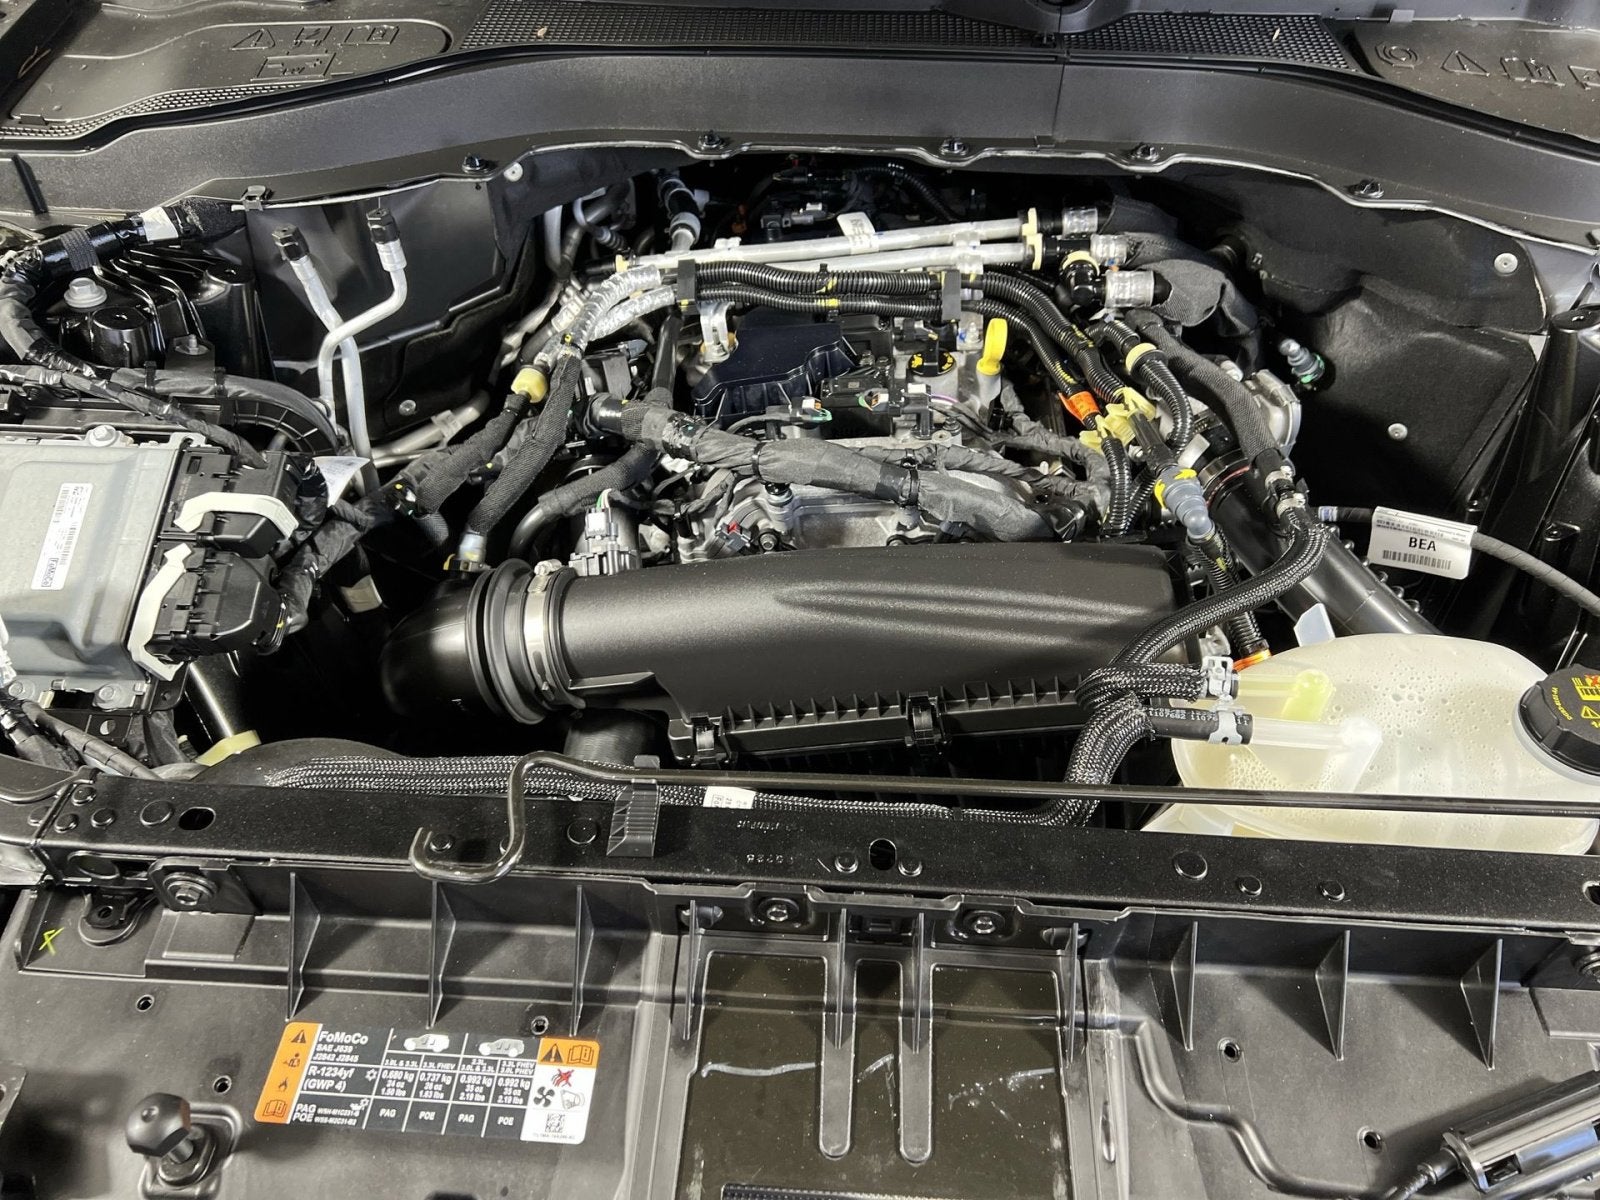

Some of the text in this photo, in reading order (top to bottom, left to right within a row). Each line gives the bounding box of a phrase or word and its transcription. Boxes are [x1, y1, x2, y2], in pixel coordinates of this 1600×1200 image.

[1408, 536, 1436, 552] BEA
[318, 1030, 369, 1045] FoMoCo
[315, 1043, 354, 1053] SAE J639
[436, 1062, 456, 1070] FHEV
[307, 1065, 355, 1080] R-1234yf
[403, 1071, 415, 1083] kg
[419, 1072, 452, 1085] 0.737 kg
[459, 1074, 493, 1088] 0.992 kg
[497, 1077, 531, 1090] 0.992 kg
[303, 1078, 347, 1092] (GWP 4)
[433, 1083, 443, 1091] oz
[465, 1084, 484, 1093] 35 oz
[395, 1088, 406, 1097] lbs
[433, 1090, 444, 1099] lbs
[503, 1087, 522, 1096] 35 oz
[474, 1093, 486, 1102] lbs
[512, 1096, 523, 1105] lbs
[295, 1103, 317, 1113] PAG
[379, 1108, 396, 1118] PAG
[292, 1112, 315, 1123] POE
[418, 1110, 436, 1121] POE
[457, 1113, 475, 1123] PAG
[497, 1116, 514, 1126] POE
